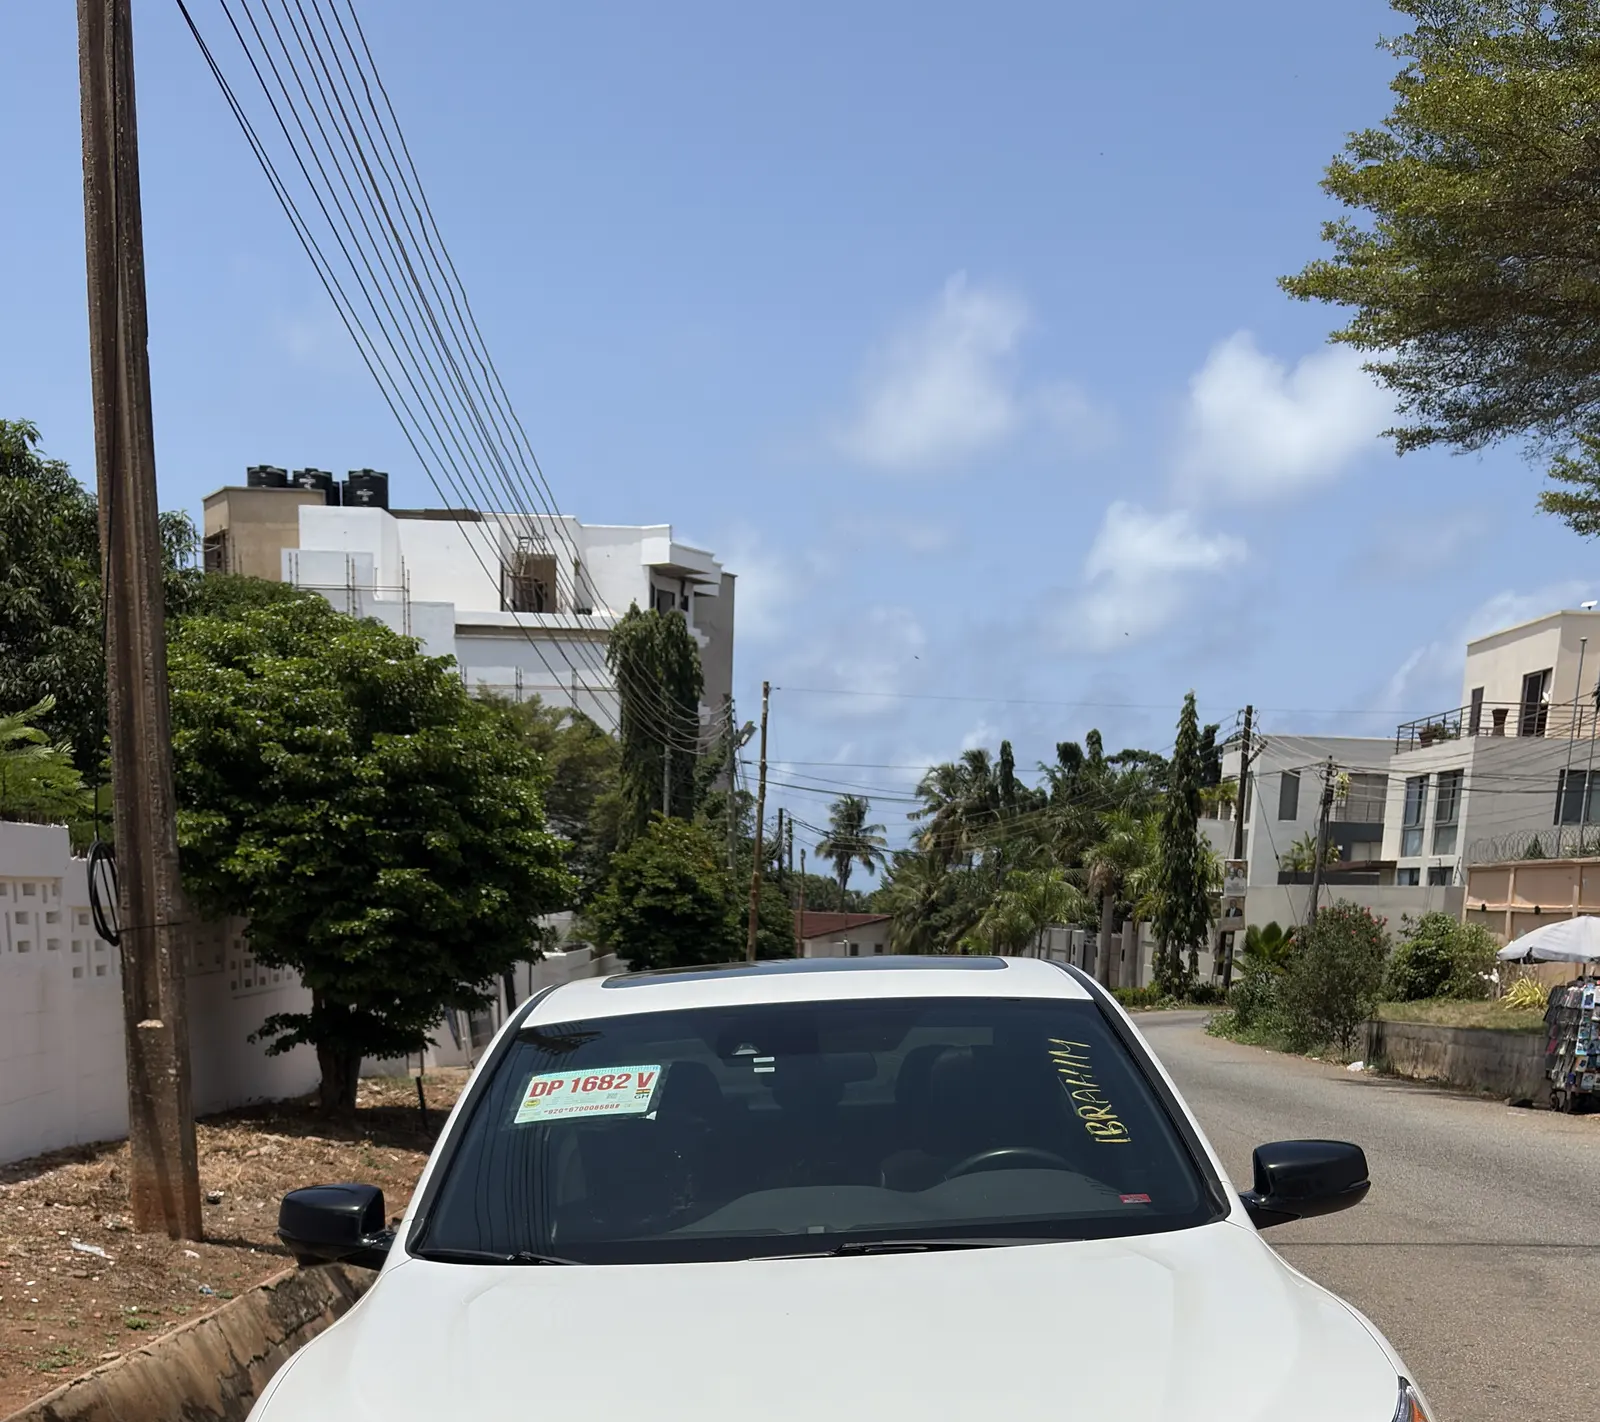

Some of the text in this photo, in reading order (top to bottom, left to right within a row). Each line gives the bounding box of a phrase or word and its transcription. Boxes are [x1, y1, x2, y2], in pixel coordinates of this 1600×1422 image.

[528, 1071, 655, 1098] DP 1682 V
[1047, 1037, 1132, 1143] IBRAHIM
